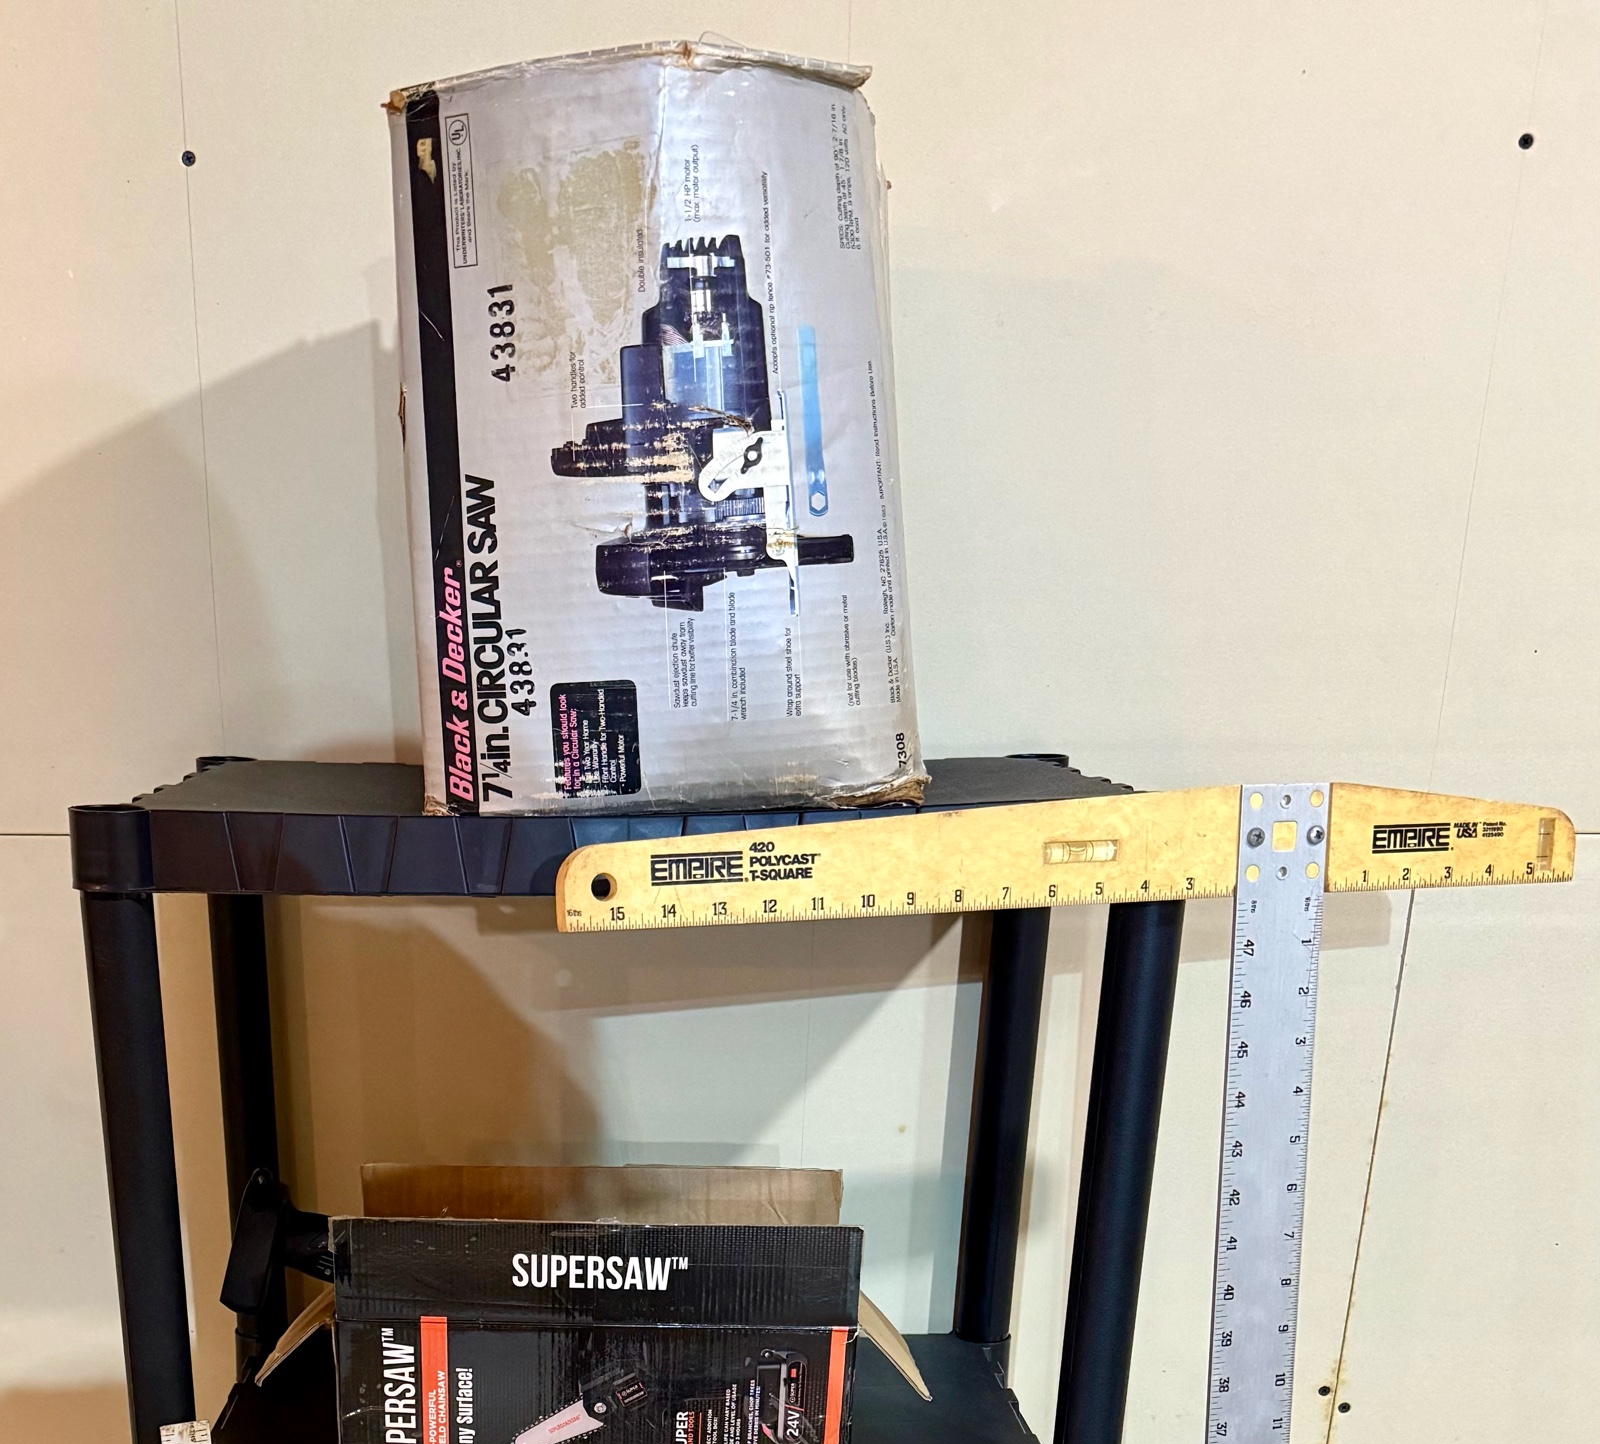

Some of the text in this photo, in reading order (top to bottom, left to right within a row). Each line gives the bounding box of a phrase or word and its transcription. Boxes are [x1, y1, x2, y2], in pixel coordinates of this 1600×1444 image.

[451, 125, 464, 141] UL
[690, 144, 700, 198] motor output)
[684, 158, 692, 222] 1-1/2 HP motor
[762, 207, 770, 231] added
[636, 228, 646, 292] Double insulated
[766, 282, 774, 301] fence
[487, 284, 516, 382] 43831
[768, 316, 778, 344] optional
[771, 346, 779, 374] Accepts
[568, 364, 578, 392] handles
[577, 359, 587, 409] added control
[465, 474, 498, 554] SAW
[469, 560, 508, 724] CIRCULAR
[687, 618, 696, 644] visibility
[842, 623, 850, 651] abrasive
[688, 644, 696, 662] better
[728, 592, 739, 720] 7-1/4 combination blade and blade
[784, 638, 792, 654] shoe
[670, 632, 680, 708] Sawdust ejection chute
[680, 659, 688, 686] sawdust
[738, 668, 746, 694] included
[438, 567, 474, 802] Black & Decker
[682, 688, 690, 707] keeps
[689, 684, 698, 706] cutting
[794, 674, 802, 698] support
[559, 694, 567, 710] look
[597, 688, 606, 730] Two-Handed
[786, 698, 794, 717] Wrap
[560, 714, 569, 739] should
[562, 742, 572, 755] you
[571, 730, 580, 759] Circular
[600, 742, 608, 765] Handle
[896, 732, 907, 768] 7308
[618, 754, 626, 782] Powerful
[1372, 826, 1451, 851] EMPIRE
[1456, 828, 1478, 839] USA
[749, 842, 775, 852] 420
[650, 854, 744, 884] EMPIRE
[749, 853, 818, 868] POLYCAST
[1402, 868, 1410, 882] 2
[1444, 866, 1452, 880] 3
[1485, 865, 1493, 878] 4
[1526, 862, 1534, 876] 5
[749, 868, 813, 882] T-SQUARE
[610, 878, 1194, 922] 15 14 13 12 11 10 9 8 7 6 5 4 3
[1244, 938, 1255, 956] 47
[1240, 990, 1252, 1008] 46
[1237, 1040, 1249, 1058] 45
[1235, 1091, 1246, 1108] 44
[1232, 1140, 1243, 1158] 43
[1229, 1188, 1240, 1206] 42
[437, 1370, 446, 1424] CHAINSAW
[455, 1368, 474, 1424] Surface!
[786, 1410, 800, 1438] 24V
